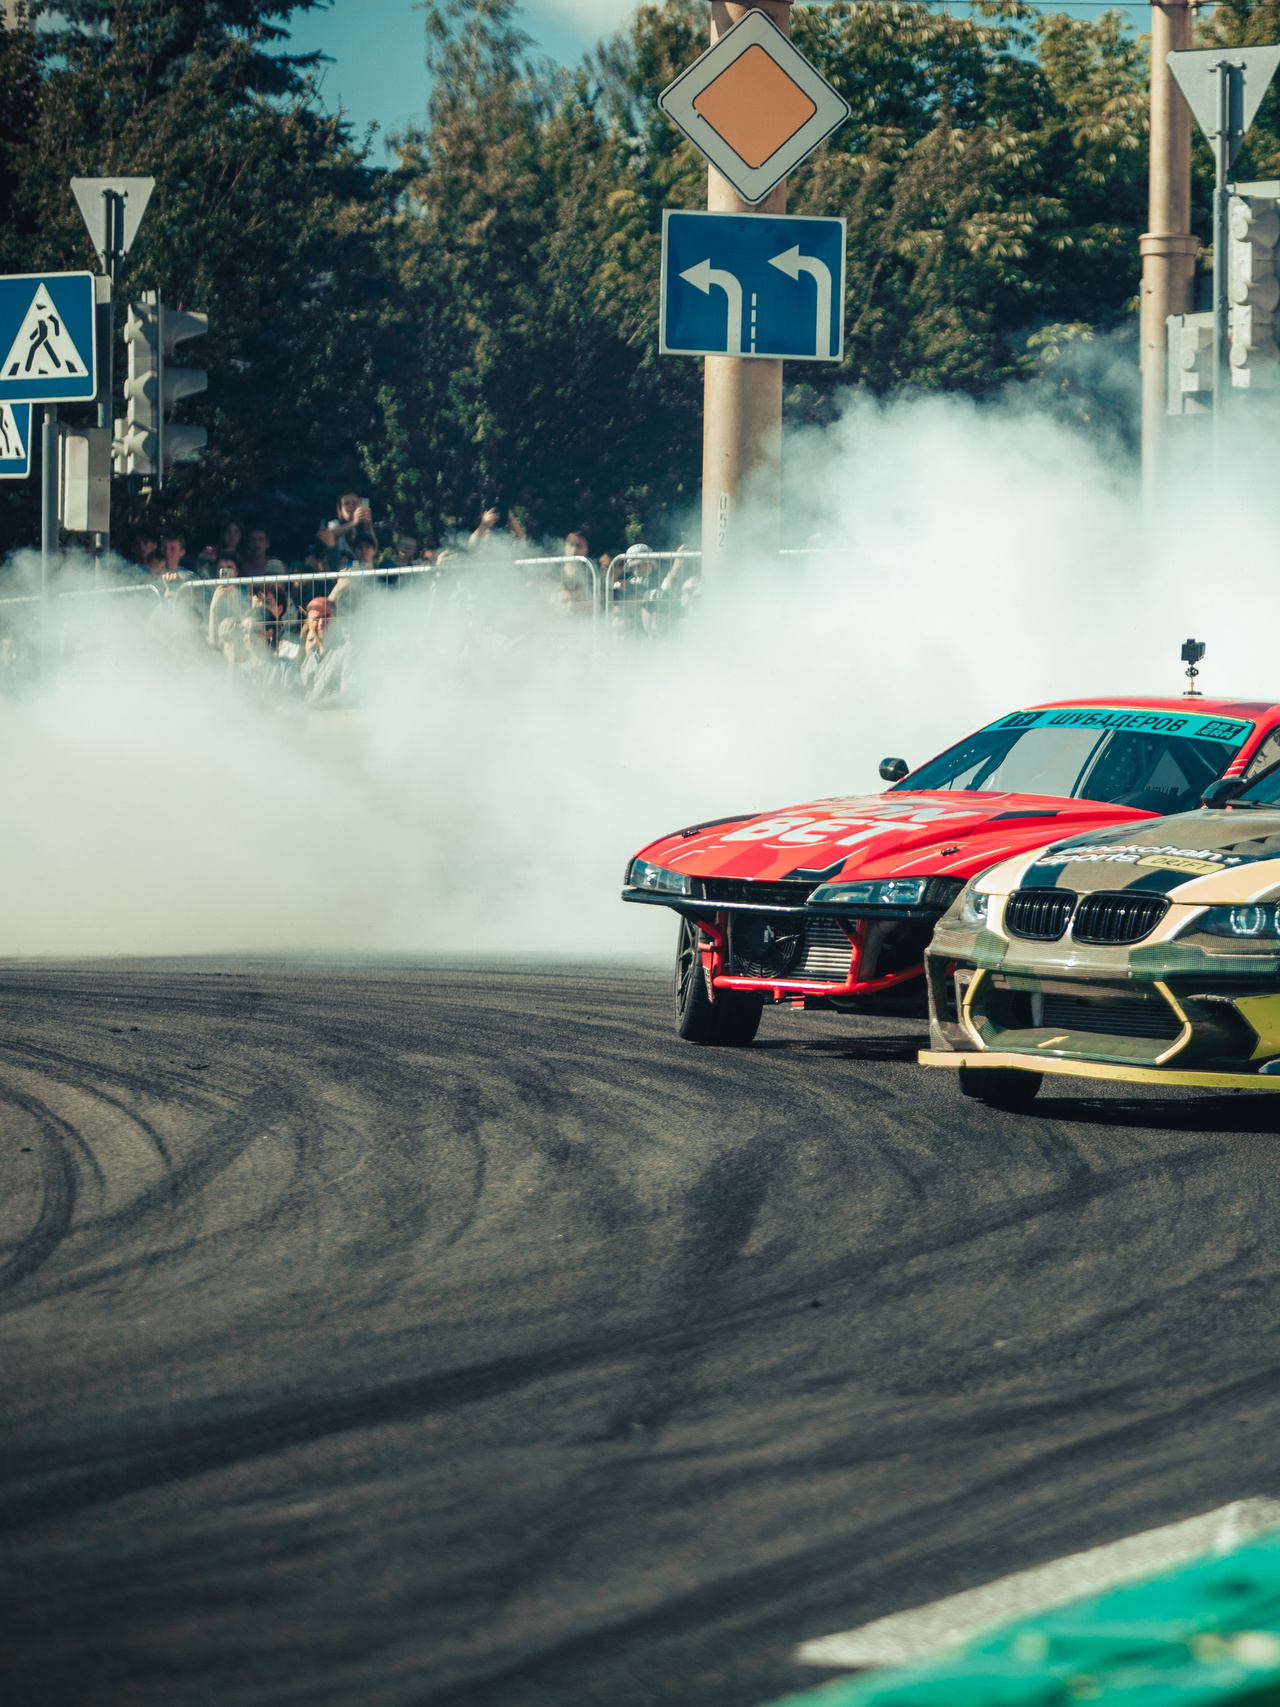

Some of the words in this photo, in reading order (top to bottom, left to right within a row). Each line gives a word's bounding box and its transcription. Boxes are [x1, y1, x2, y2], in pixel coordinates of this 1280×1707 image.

[1009, 713, 1038, 727] 19
[1047, 712, 1189, 732] ШУБАДЁРОВ
[1206, 721, 1243, 731] BET
[719, 816, 929, 846] BET
[1151, 857, 1213, 872] DRIFT
